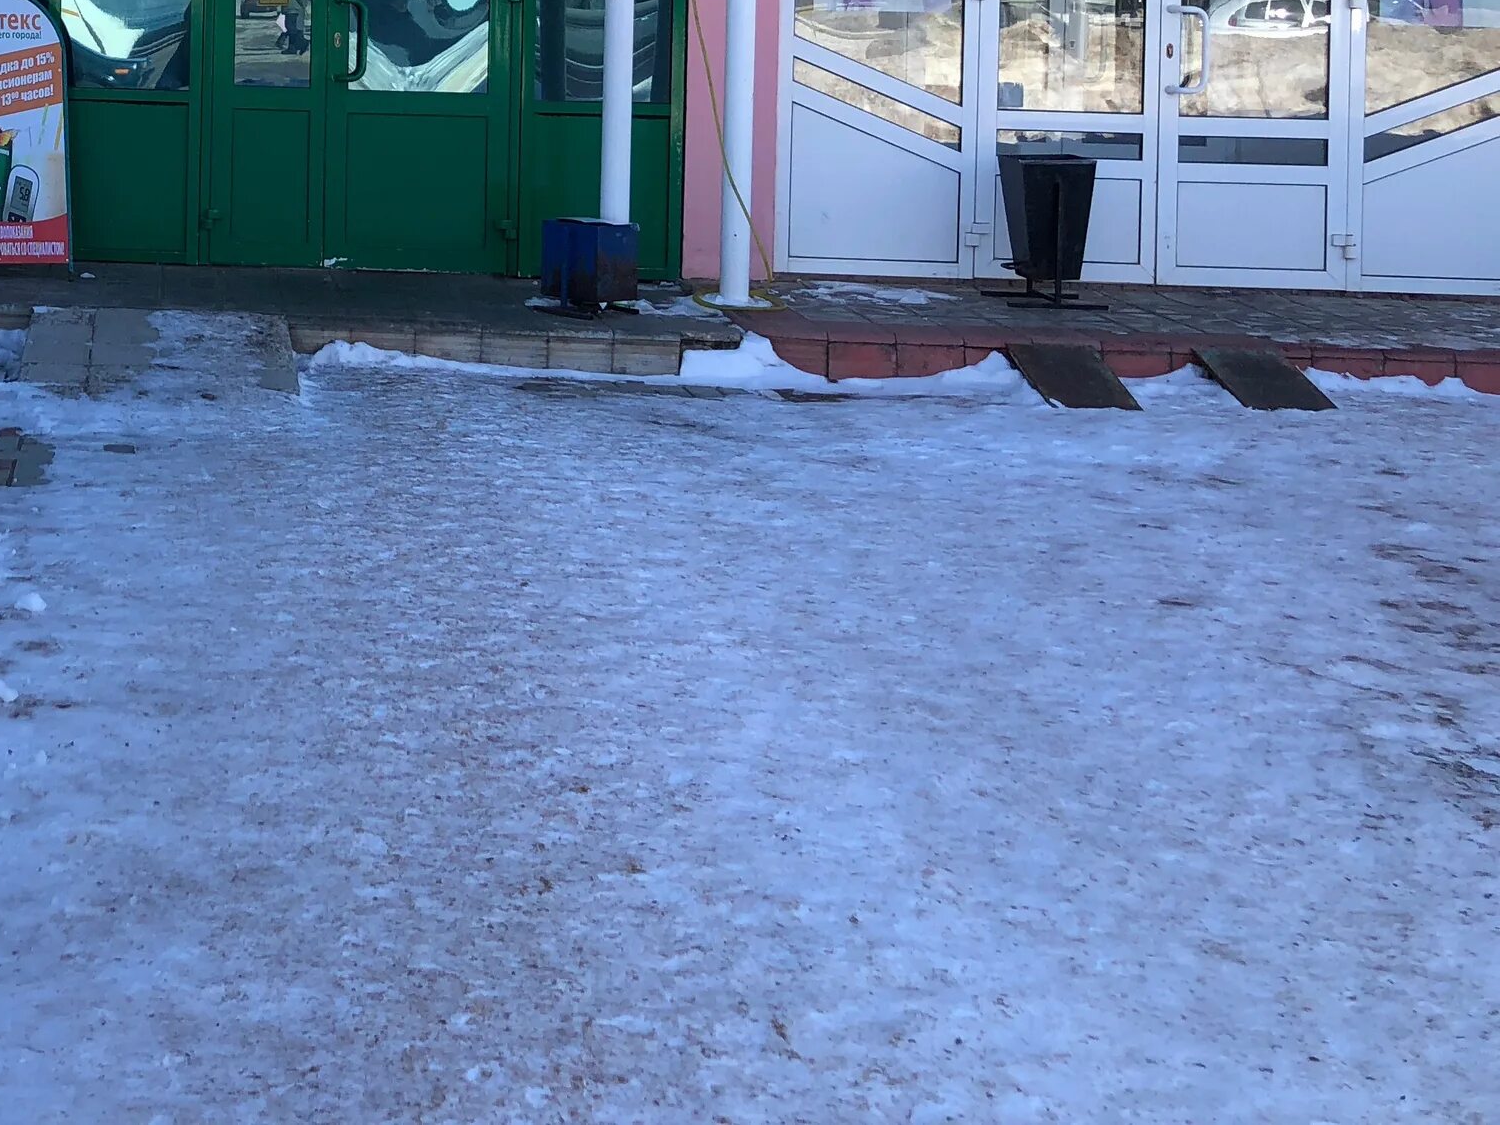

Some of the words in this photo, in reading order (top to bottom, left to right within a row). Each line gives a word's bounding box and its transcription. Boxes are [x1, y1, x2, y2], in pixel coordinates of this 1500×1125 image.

[12, 31, 42, 40] города!
[21, 59, 34, 71] до
[36, 51, 55, 67] 15%
[21, 84, 54, 102] часов!
